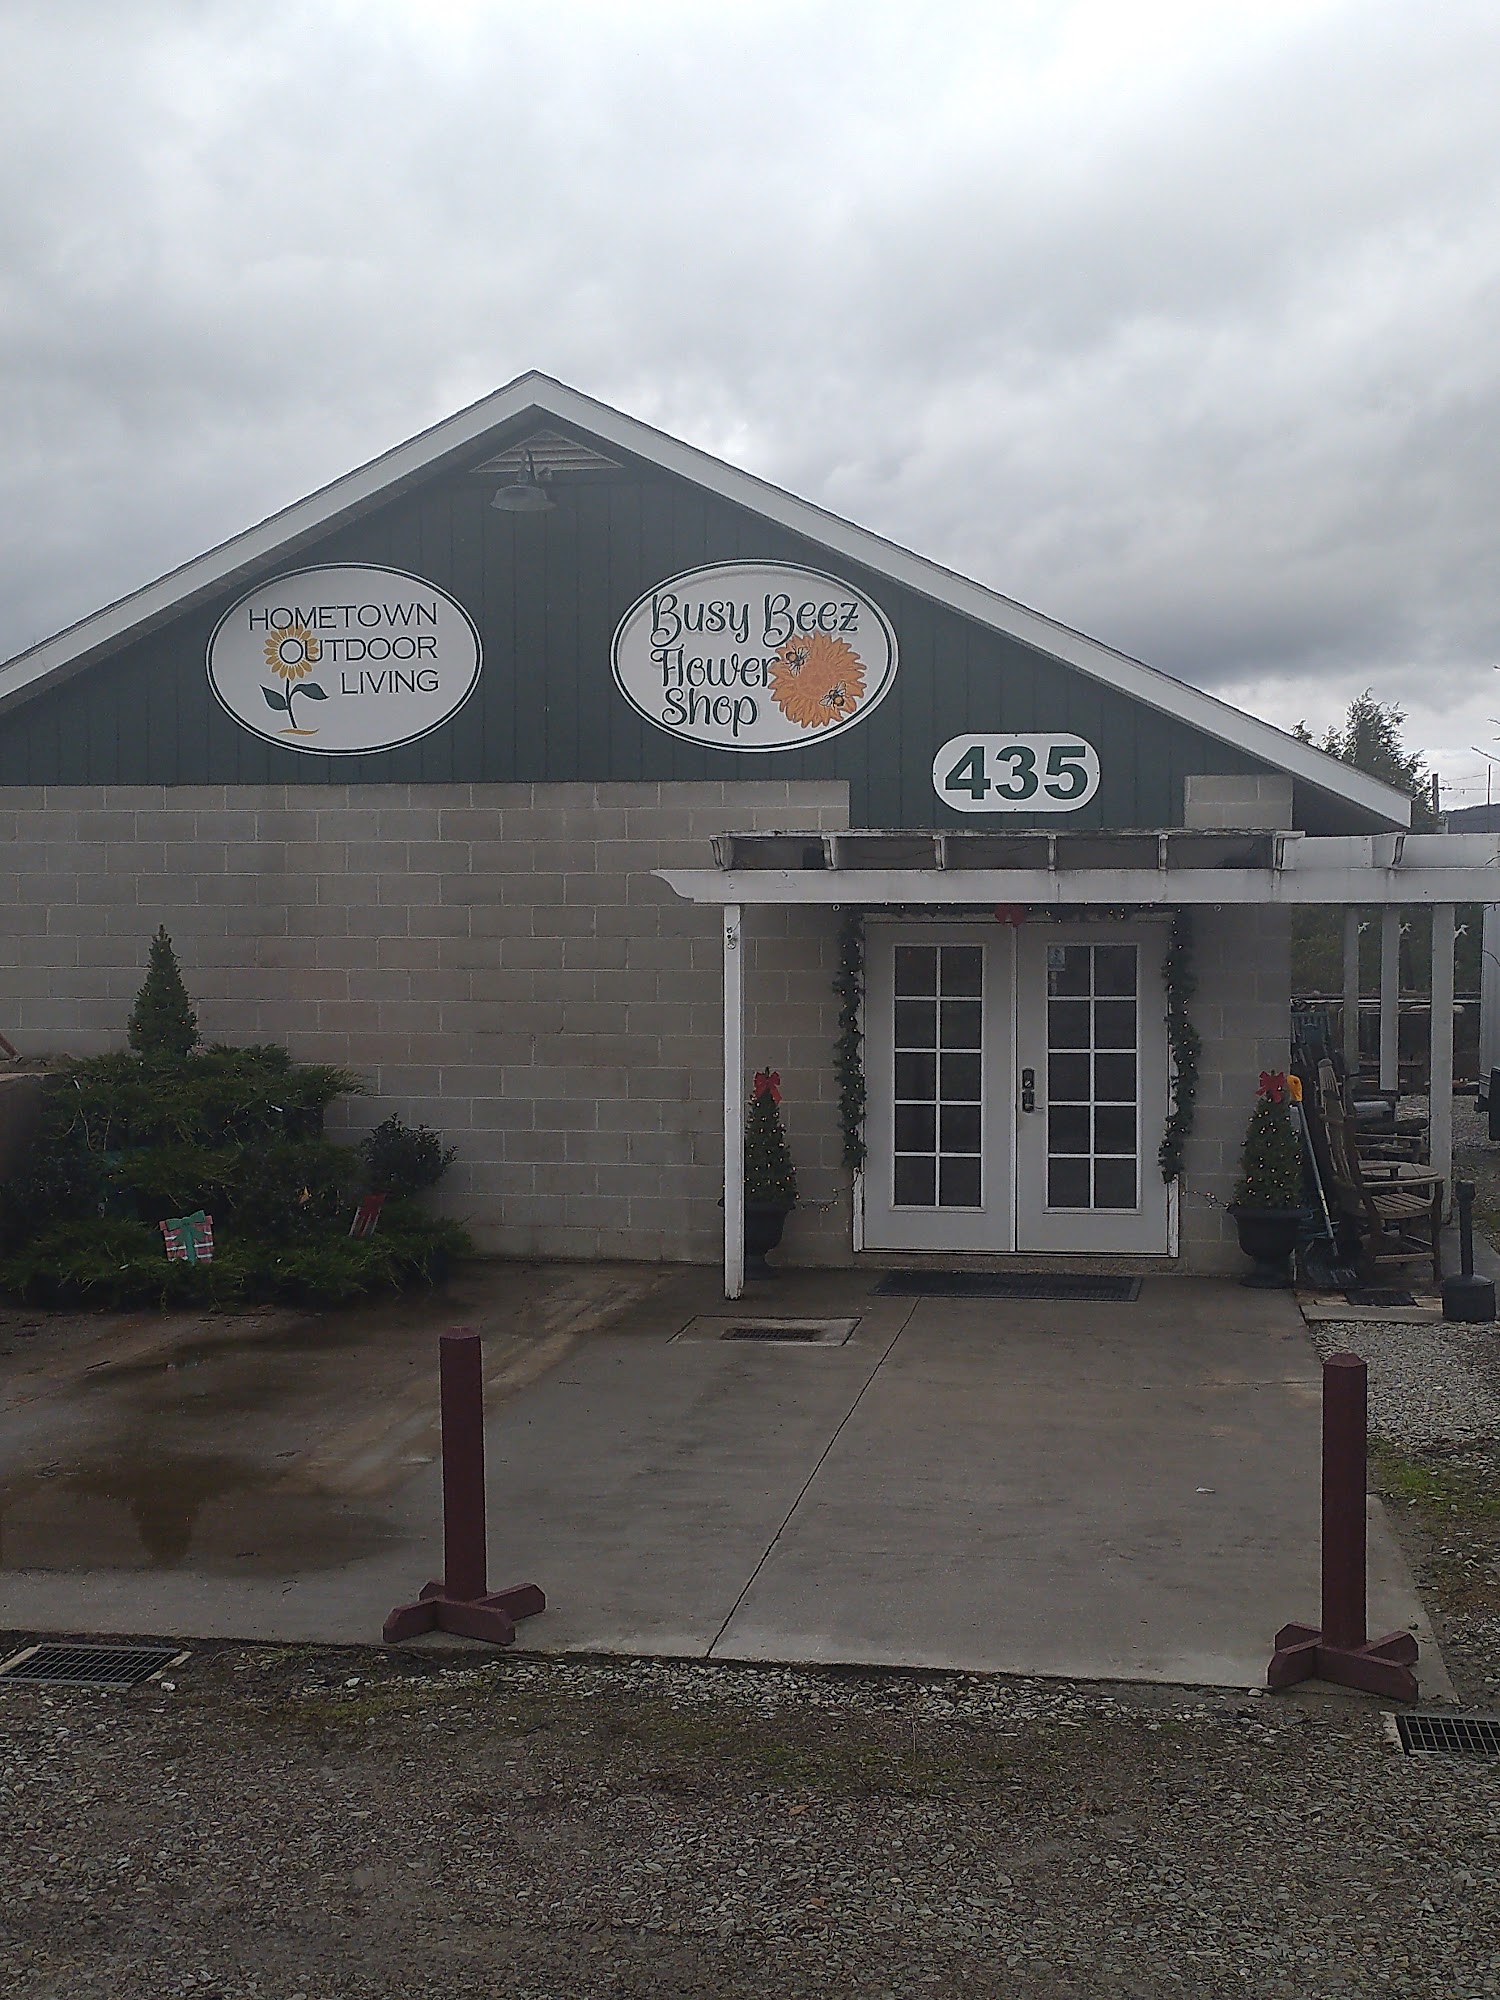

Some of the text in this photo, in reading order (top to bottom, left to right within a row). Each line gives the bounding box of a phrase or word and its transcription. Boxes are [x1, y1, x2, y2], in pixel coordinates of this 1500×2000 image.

[249, 602, 438, 631] HOMETOWN
[650, 594, 859, 648] Busy Beez
[279, 636, 438, 664] OUTDOOR
[650, 644, 780, 687] Flower
[341, 669, 439, 695] LIVING
[662, 687, 758, 737] Shop
[945, 745, 1088, 800] 435
